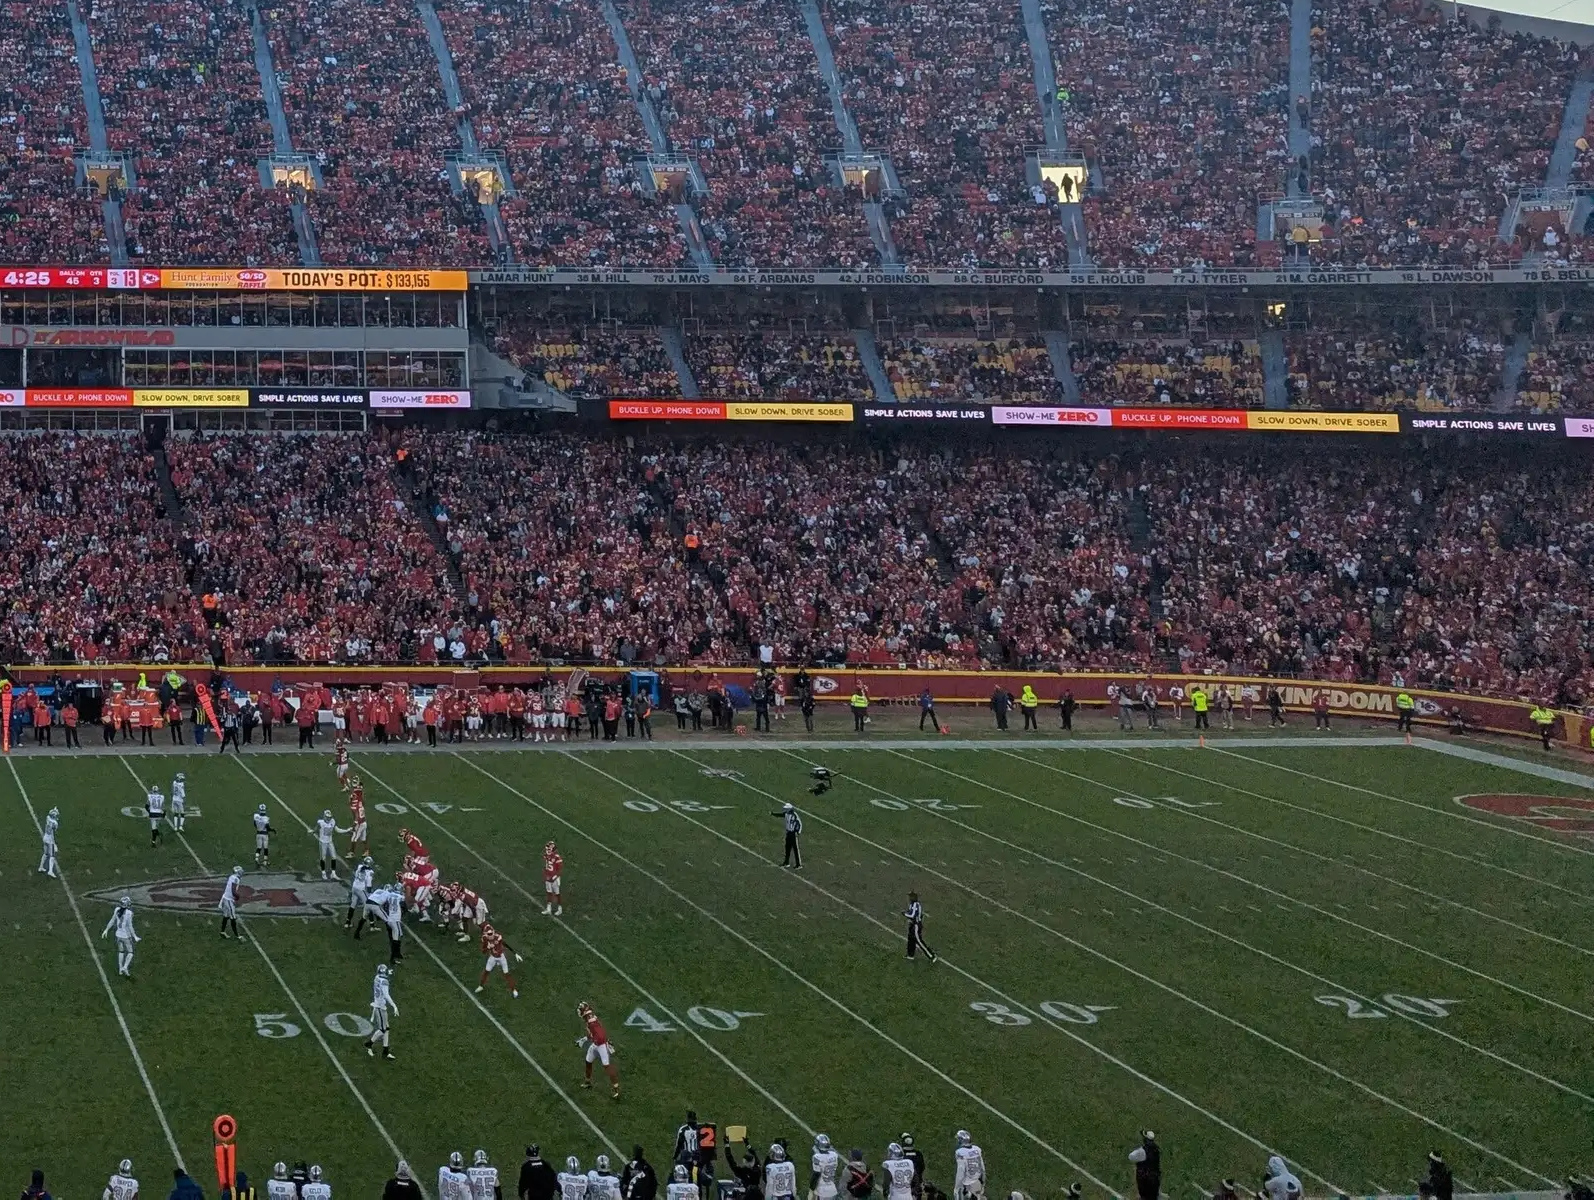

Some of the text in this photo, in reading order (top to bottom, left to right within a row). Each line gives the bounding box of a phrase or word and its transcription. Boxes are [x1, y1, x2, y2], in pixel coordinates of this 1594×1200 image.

[5, 272, 50, 284] 4:25
[66, 277, 79, 285] 45
[93, 277, 100, 285] 3
[123, 271, 136, 286] 13
[172, 272, 233, 284] Hunt Family
[282, 272, 430, 287] TODAY'S POT: $133,155
[480, 274, 554, 282] LAMAR HUNT
[591, 274, 603, 283] M.
[606, 274, 630, 283] HILL
[666, 275, 676, 283] J.
[679, 275, 709, 283] MAYS
[748, 275, 756, 283] F.
[759, 275, 815, 283] ARBANAS
[839, 275, 929, 283] 42 J. ROBINSON
[970, 275, 983, 283] C.
[985, 275, 1044, 283] BURFORD
[1071, 275, 1145, 284] 55 E. HOLUB
[1173, 274, 1247, 284] 77 J. TYRER
[1276, 274, 1371, 283] 21 M. GARRETT
[1417, 273, 1428, 282] L.
[1432, 272, 1493, 282] DAWSON
[1559, 271, 1594, 280] BELL
[47, 330, 175, 345] ARROWHEAD
[619, 405, 721, 416] BUCKLE UP, PHONE DOWN
[735, 407, 844, 417] SLOW DOWN, DRIVE SOBER
[864, 408, 985, 419] SIMPLE ACTIONS SAVE LIVES
[1006, 411, 1099, 422] SHOW-ME ZERO
[1121, 413, 1240, 424] BUCKLE UP, PHONE DOWN
[1257, 416, 1388, 427] SLOW DOWN, DRIVE SOBER
[1412, 420, 1555, 431] SIMPLE ACTIONS SAVE LIVES
[1313, 994, 1451, 1019] 20
[969, 1001, 1098, 1025] 30
[625, 1006, 739, 1032] 40
[254, 1012, 373, 1039] 50
[700, 1127, 715, 1147] 2
